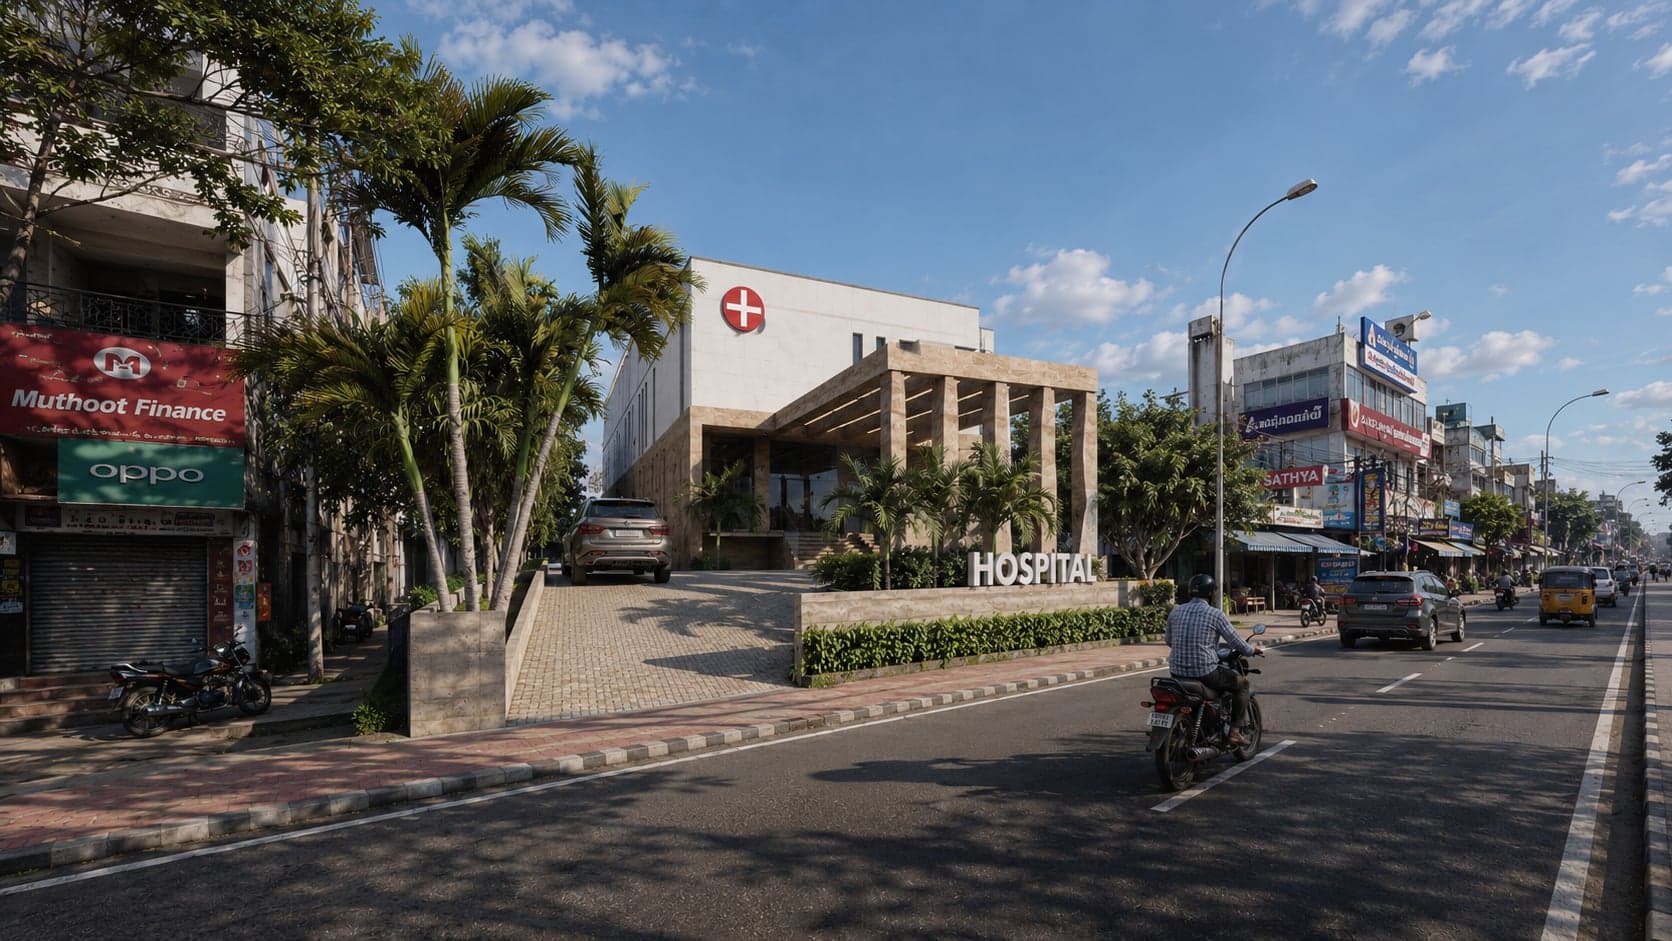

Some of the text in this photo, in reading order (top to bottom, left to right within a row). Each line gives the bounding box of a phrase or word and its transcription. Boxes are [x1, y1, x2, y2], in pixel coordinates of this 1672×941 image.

[12, 388, 227, 422] Muthoot Finance
[1263, 470, 1319, 487] SATHYA
[969, 551, 1097, 586] HOSPITAL
